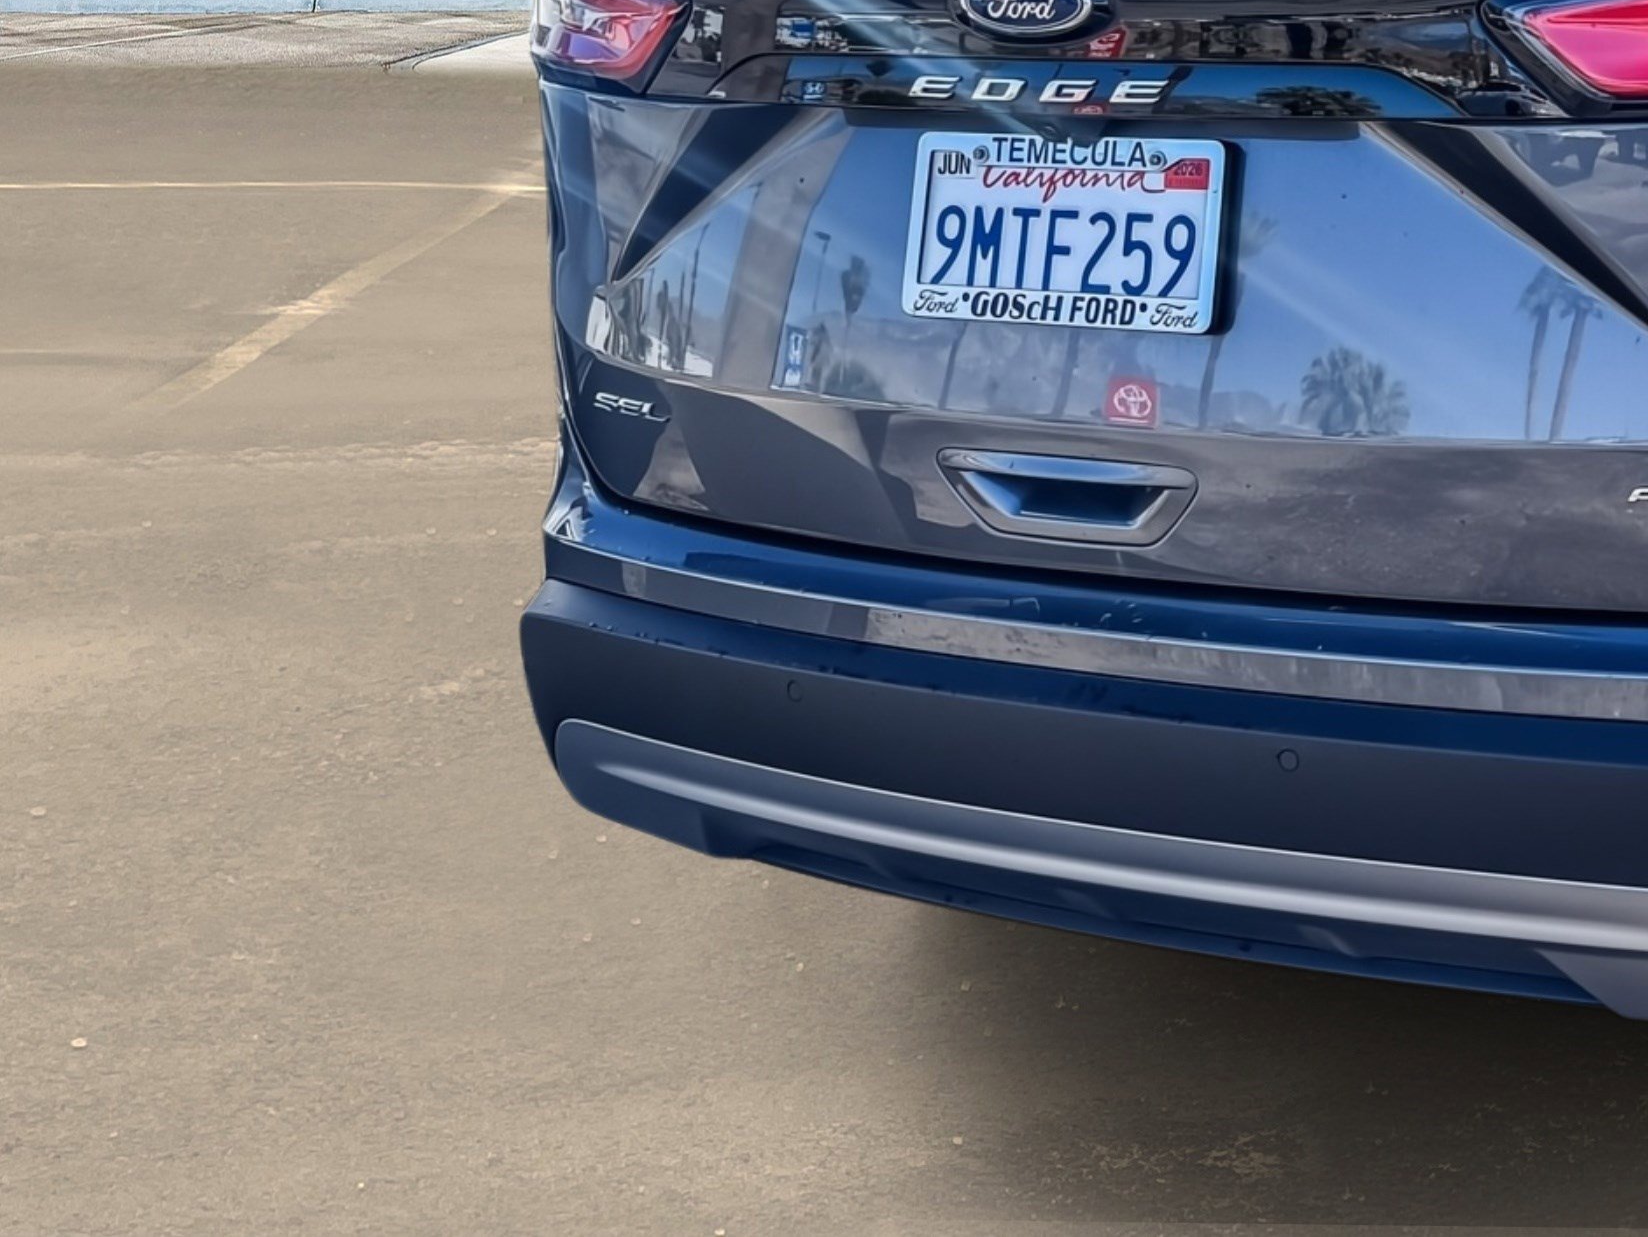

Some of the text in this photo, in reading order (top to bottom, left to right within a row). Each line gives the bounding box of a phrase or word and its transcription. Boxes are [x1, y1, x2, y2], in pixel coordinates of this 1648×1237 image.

[908, 74, 1169, 103] EDGE
[937, 152, 971, 175] JUN
[991, 137, 1147, 167] TEMECULA
[982, 166, 1166, 203] California
[929, 204, 1196, 298] 9MTF259
[913, 289, 960, 313] Ford
[1069, 295, 1136, 325] FORD
[1150, 303, 1200, 328] Ford
[594, 392, 671, 422] SEL
